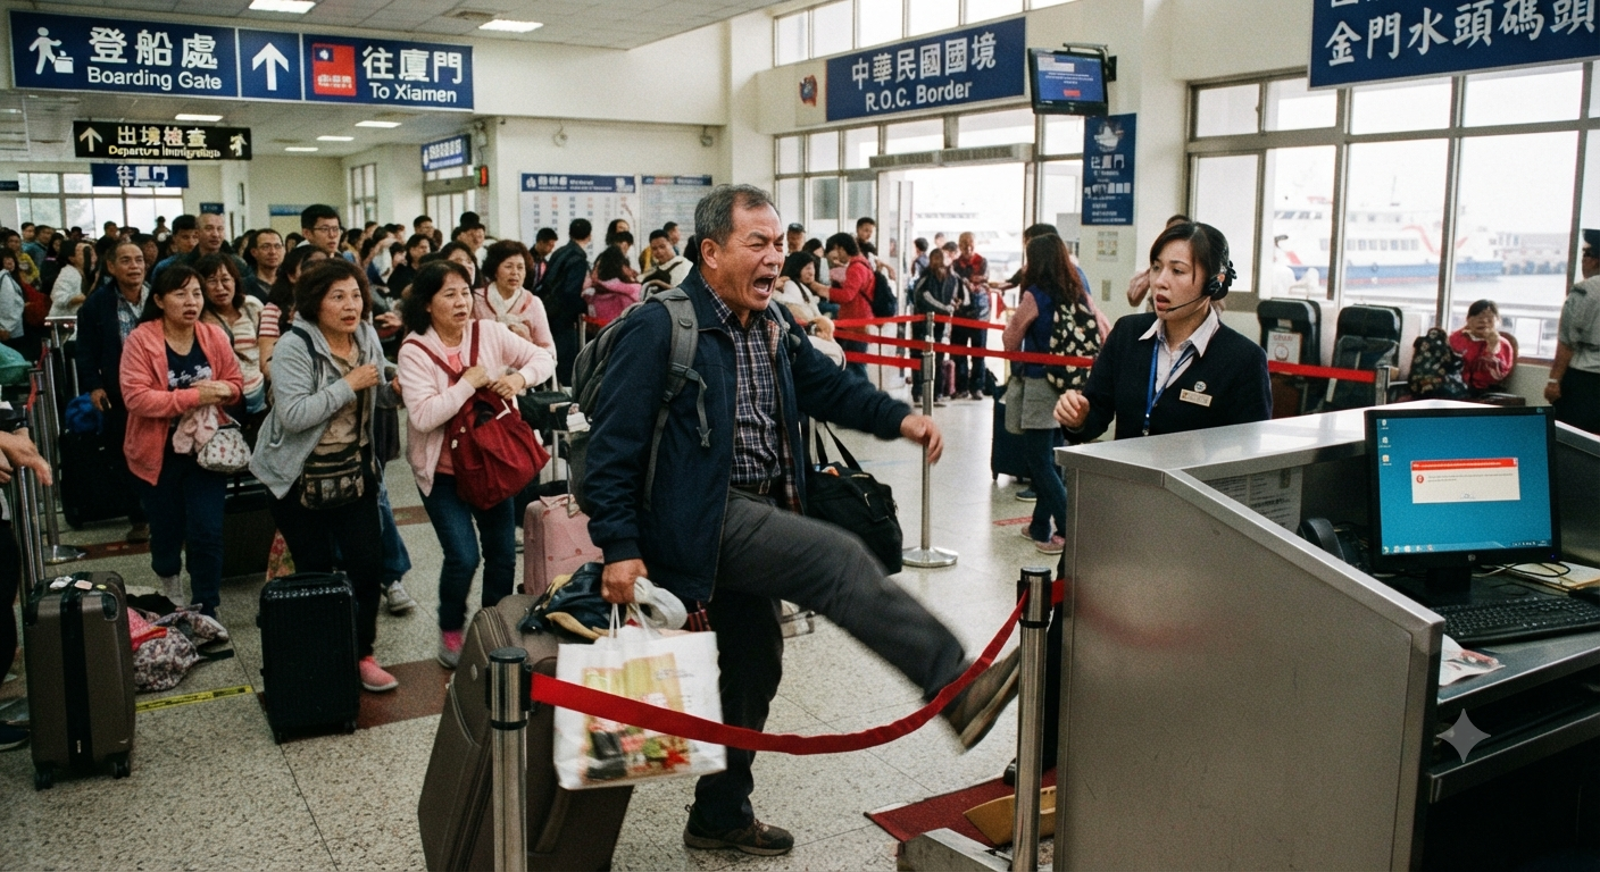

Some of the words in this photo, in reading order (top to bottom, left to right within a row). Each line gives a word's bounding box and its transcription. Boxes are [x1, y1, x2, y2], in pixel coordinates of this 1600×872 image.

[88, 26, 218, 70] 登船處
[1325, 0, 1595, 66] 金門水頭碼頭
[87, 66, 172, 91] Boarding
[178, 71, 222, 90] Gate
[851, 31, 997, 90] 中華民國國境
[369, 82, 391, 99] To
[394, 84, 457, 103] Xiamen
[866, 87, 911, 112] R.O.C.
[916, 79, 973, 104] Border
